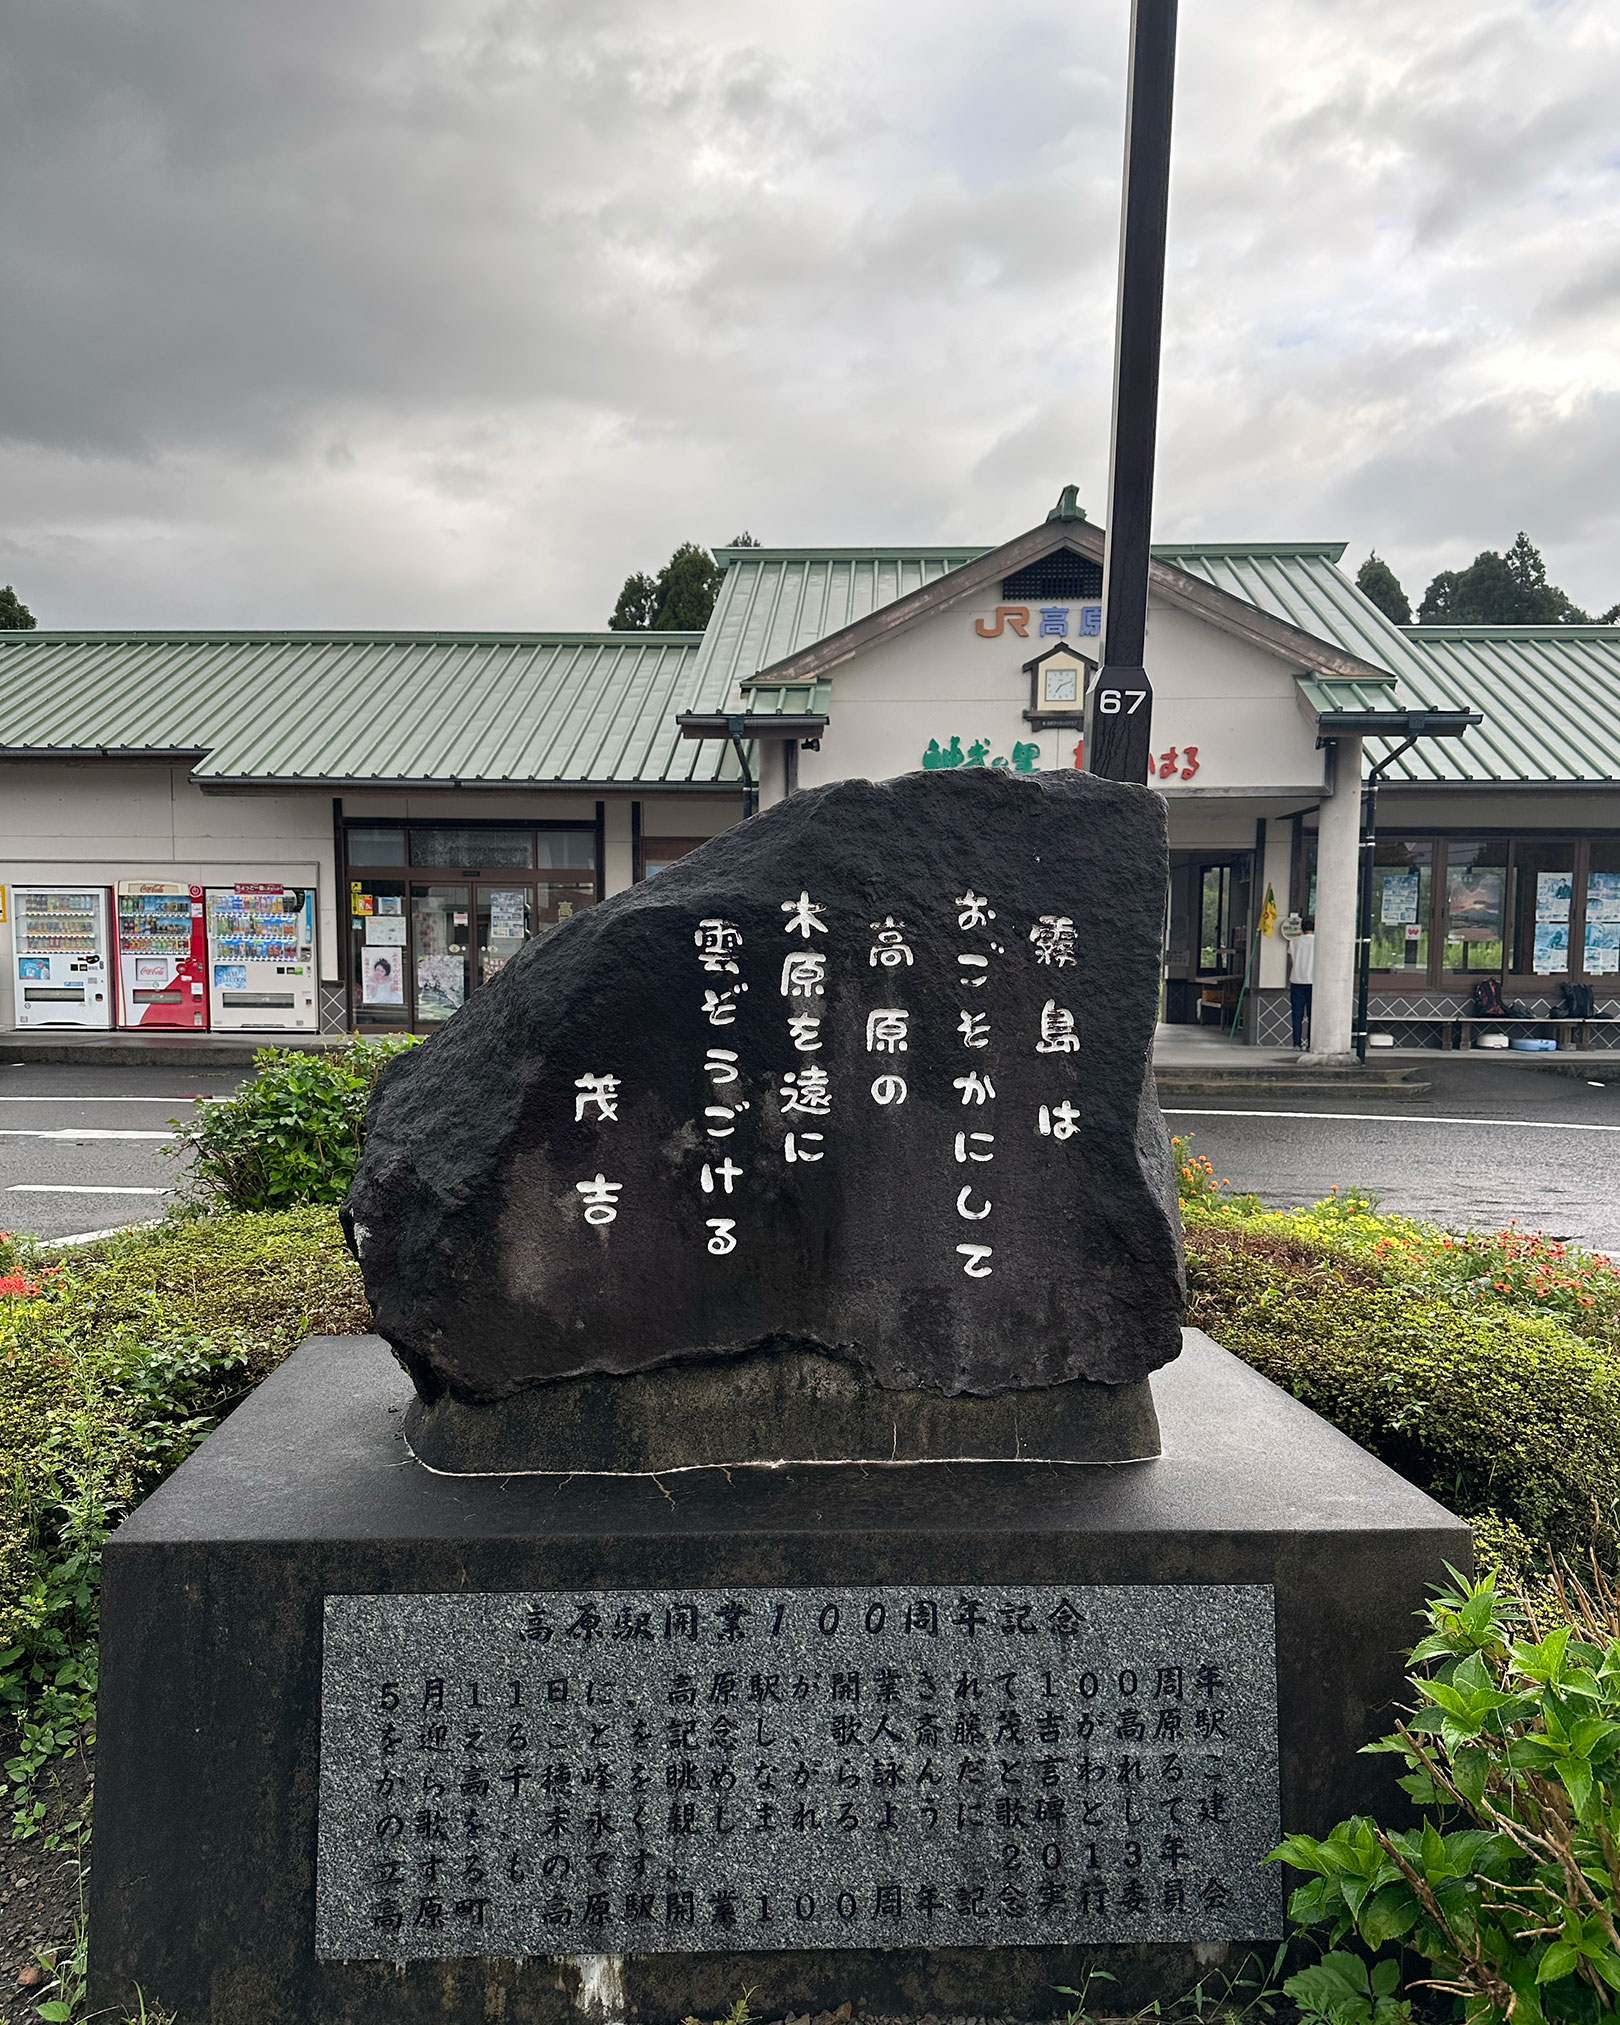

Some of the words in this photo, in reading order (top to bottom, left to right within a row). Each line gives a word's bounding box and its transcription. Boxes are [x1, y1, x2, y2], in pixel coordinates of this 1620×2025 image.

[1100, 690, 1146, 714] 67
[694, 918, 750, 1255] 雲ぞうごける
[780, 891, 832, 1162] 木原を遠に
[866, 915, 914, 1105] 高原の
[953, 889, 1005, 1278] おごそかにして
[1029, 915, 1081, 1140] 霧島は
[574, 1072, 623, 1225] 茂吉
[519, 1602, 1086, 1645] 高原駅開業100周年記念
[1002, 1834, 1190, 1871] 2013年
